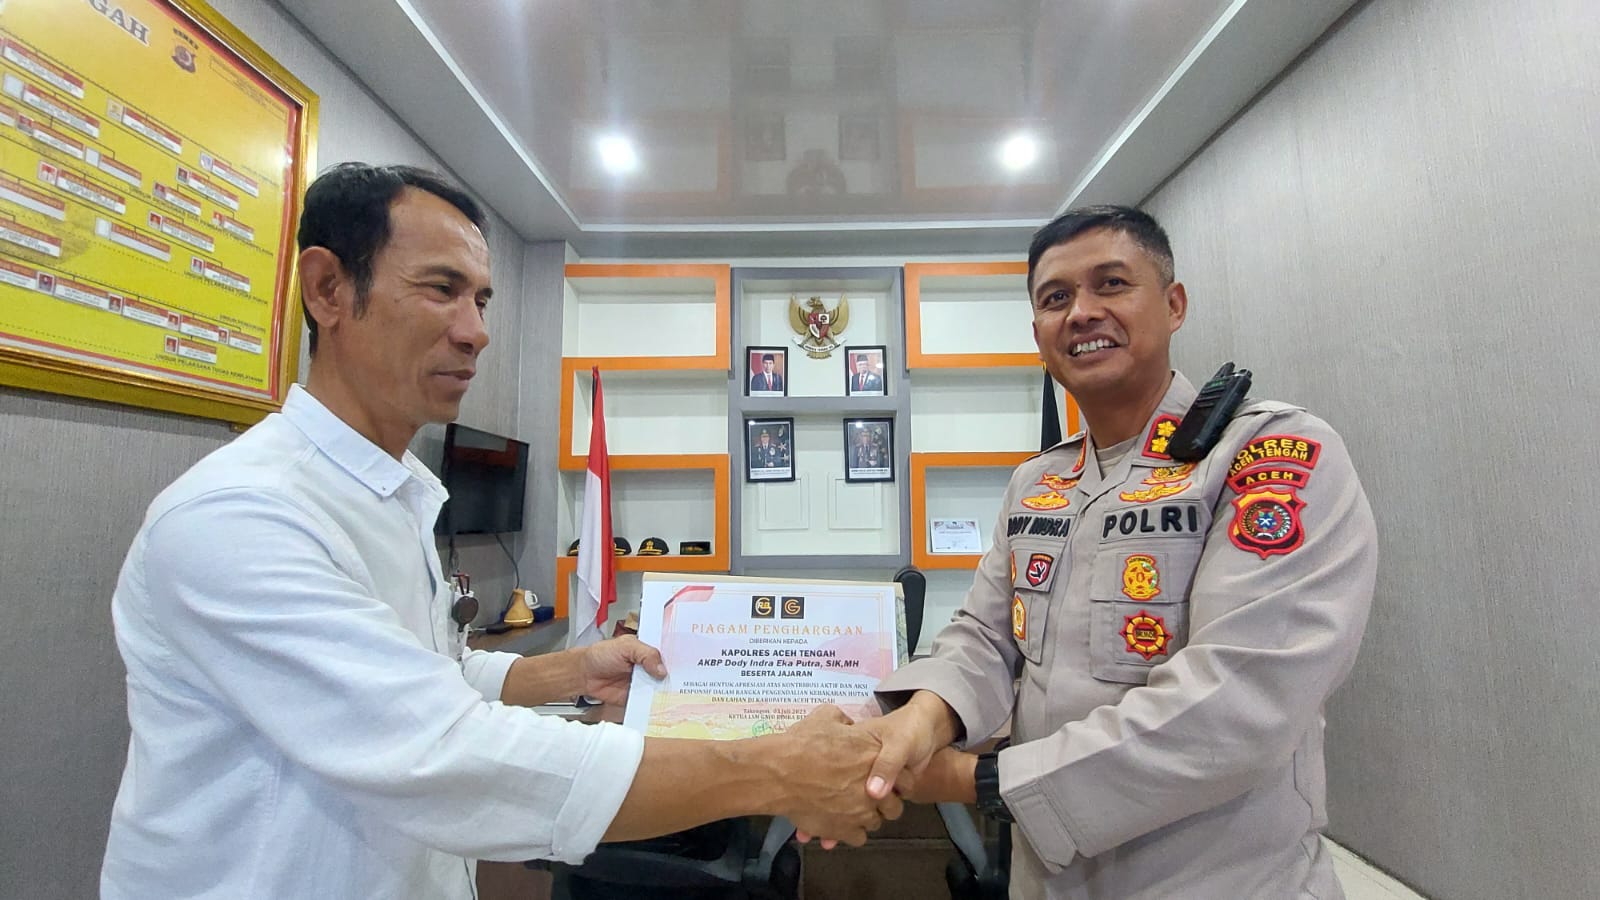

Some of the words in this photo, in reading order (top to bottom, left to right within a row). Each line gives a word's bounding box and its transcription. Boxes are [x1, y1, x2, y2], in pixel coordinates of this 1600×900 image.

[1231, 439, 1308, 468] OLRES
[1258, 447, 1308, 461] TENGAH
[1246, 471, 1294, 485] ACEH
[1103, 505, 1198, 538] POLRI
[692, 623, 748, 634] PIAGAM
[754, 624, 863, 635] PENGHARGAAN
[721, 649, 770, 657] KAPOLRES
[773, 649, 797, 657] ACEH
[799, 650, 836, 658] TENGAH
[697, 659, 723, 667] AKBP
[724, 659, 748, 669] Dody
[749, 659, 774, 667] Indra
[776, 660, 794, 668] Eka
[796, 660, 823, 669] Putra,
